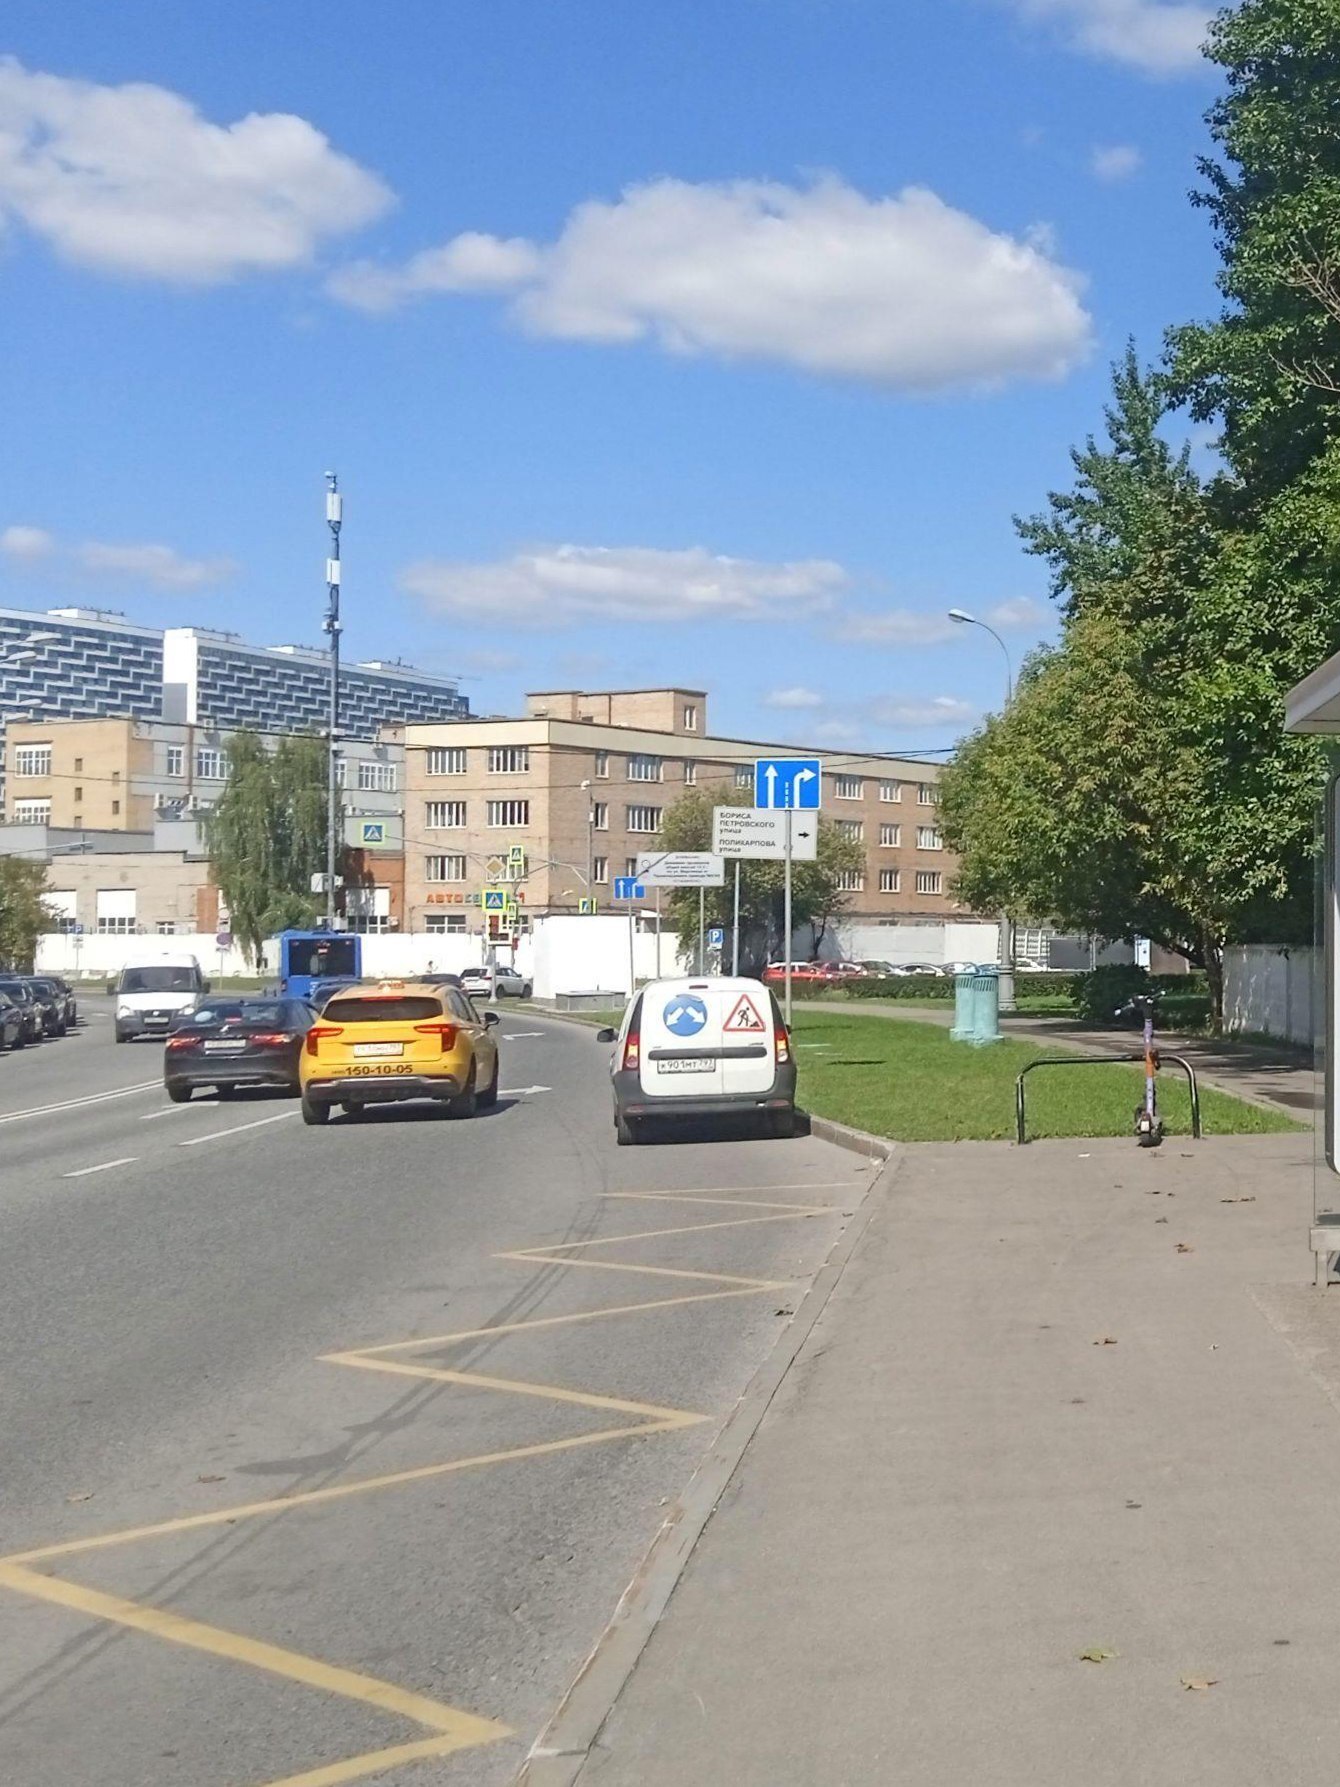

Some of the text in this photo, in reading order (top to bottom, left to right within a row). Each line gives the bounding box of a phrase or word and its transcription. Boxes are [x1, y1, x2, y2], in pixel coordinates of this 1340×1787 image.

[720, 820, 775, 828] ПЕТРОВСКОГО
[719, 839, 776, 847] ПОЛИКАРПОВА
[345, 1064, 413, 1075] 150-10-05
